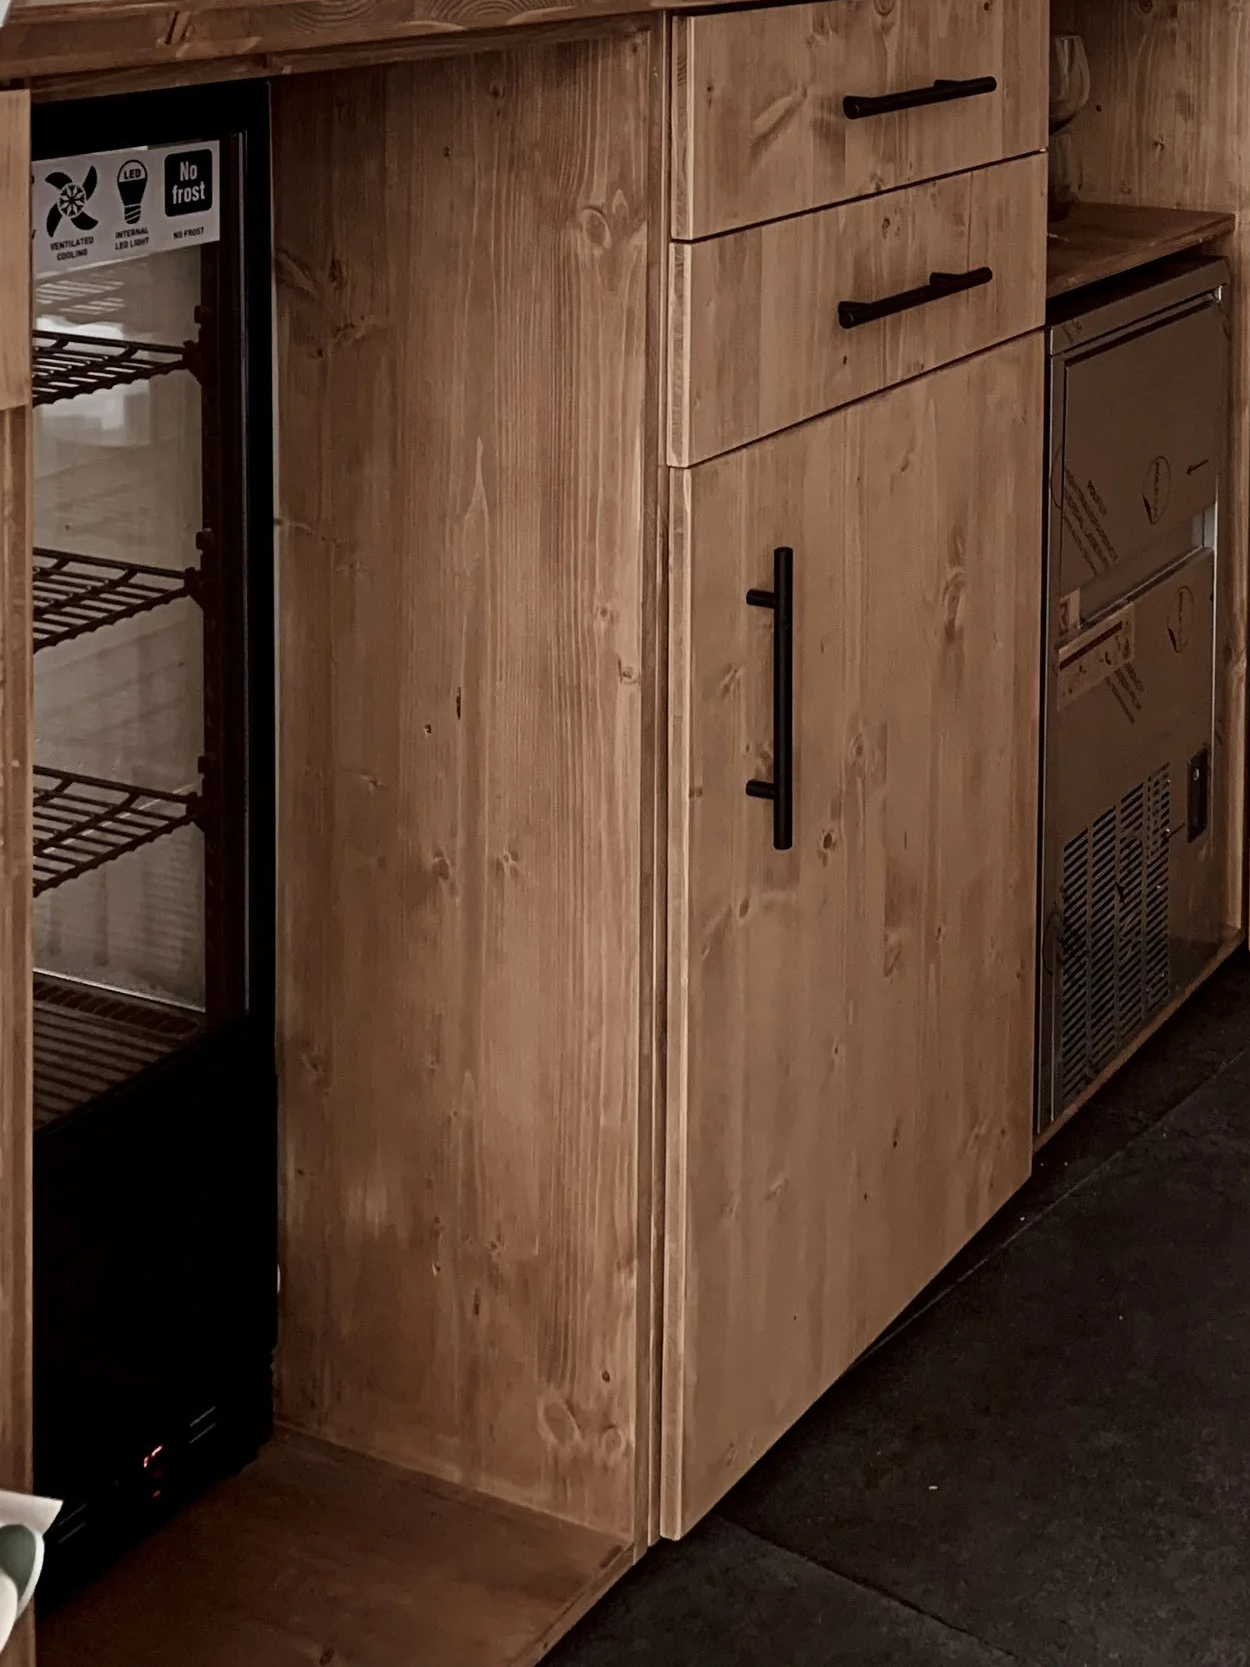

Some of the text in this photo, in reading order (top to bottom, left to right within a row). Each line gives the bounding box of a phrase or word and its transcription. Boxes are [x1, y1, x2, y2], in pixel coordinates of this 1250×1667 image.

[124, 169, 141, 180] LED
[180, 161, 198, 182] No
[172, 181, 205, 205] frost
[115, 226, 149, 239] INTERNAL
[173, 227, 204, 240] NO FROST
[50, 236, 94, 252] VENTILATED
[115, 237, 150, 251] LED LIGHT
[56, 248, 88, 262] COOLING
